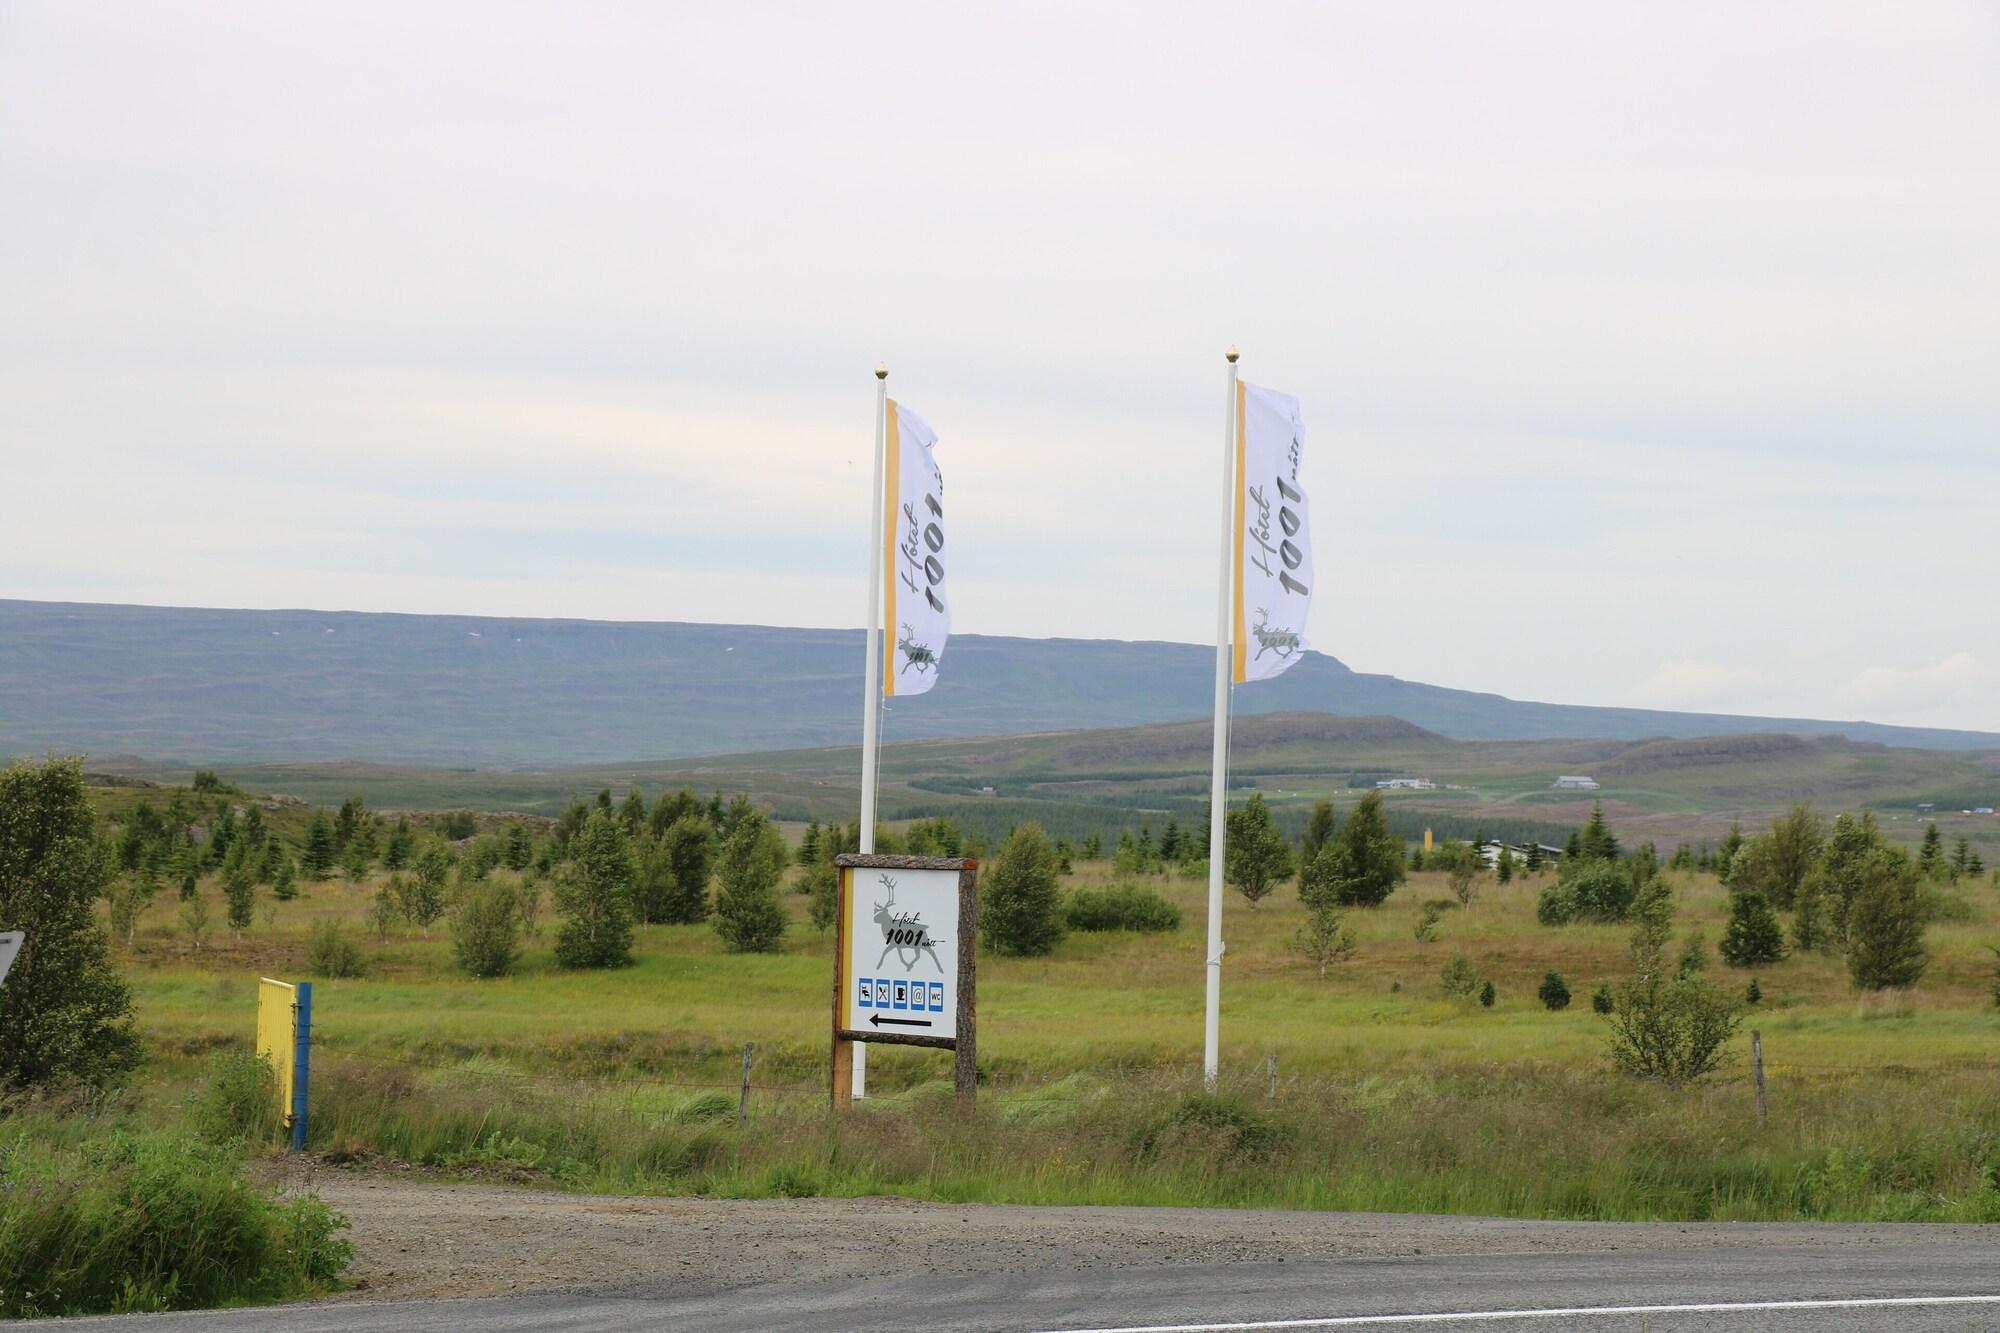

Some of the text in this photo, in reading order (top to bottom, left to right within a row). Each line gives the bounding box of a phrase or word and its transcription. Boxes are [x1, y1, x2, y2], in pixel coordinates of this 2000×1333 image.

[924, 492, 944, 613] 1001
[1277, 476, 1309, 596] 1001
[886, 929, 923, 946] 1001
[931, 993, 941, 1001] WC
